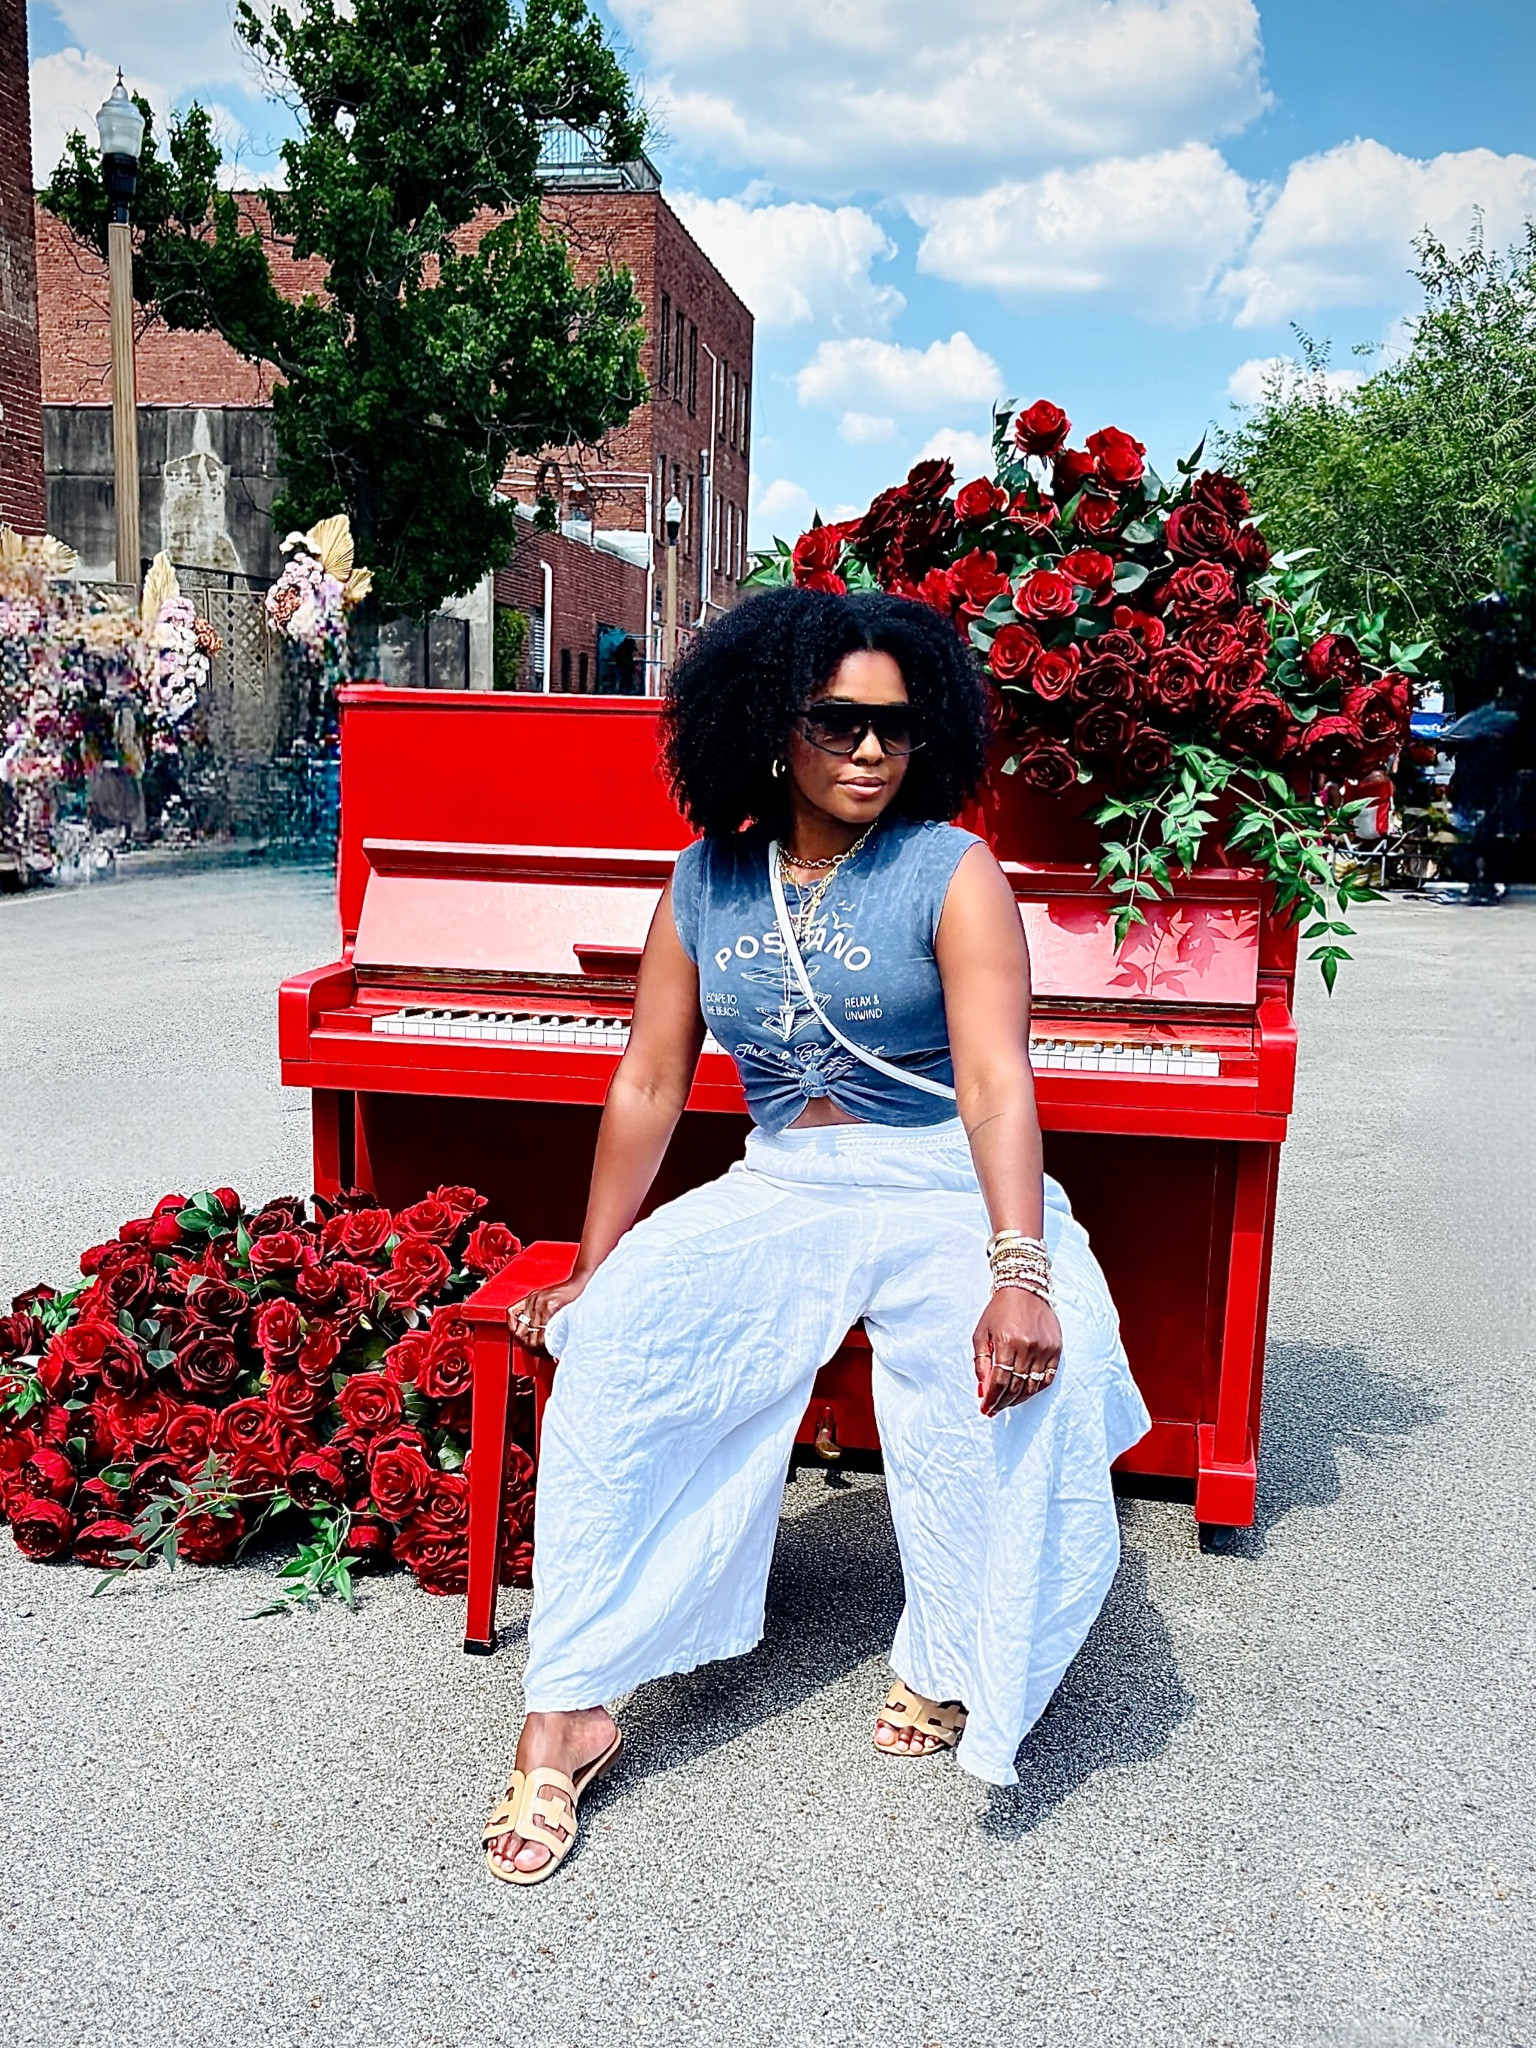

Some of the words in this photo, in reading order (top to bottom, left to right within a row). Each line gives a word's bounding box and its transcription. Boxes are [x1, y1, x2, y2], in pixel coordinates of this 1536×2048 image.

[844, 995, 872, 1008] RELAX
[873, 993, 880, 1005] &
[844, 1007, 883, 1021] UNWIND
